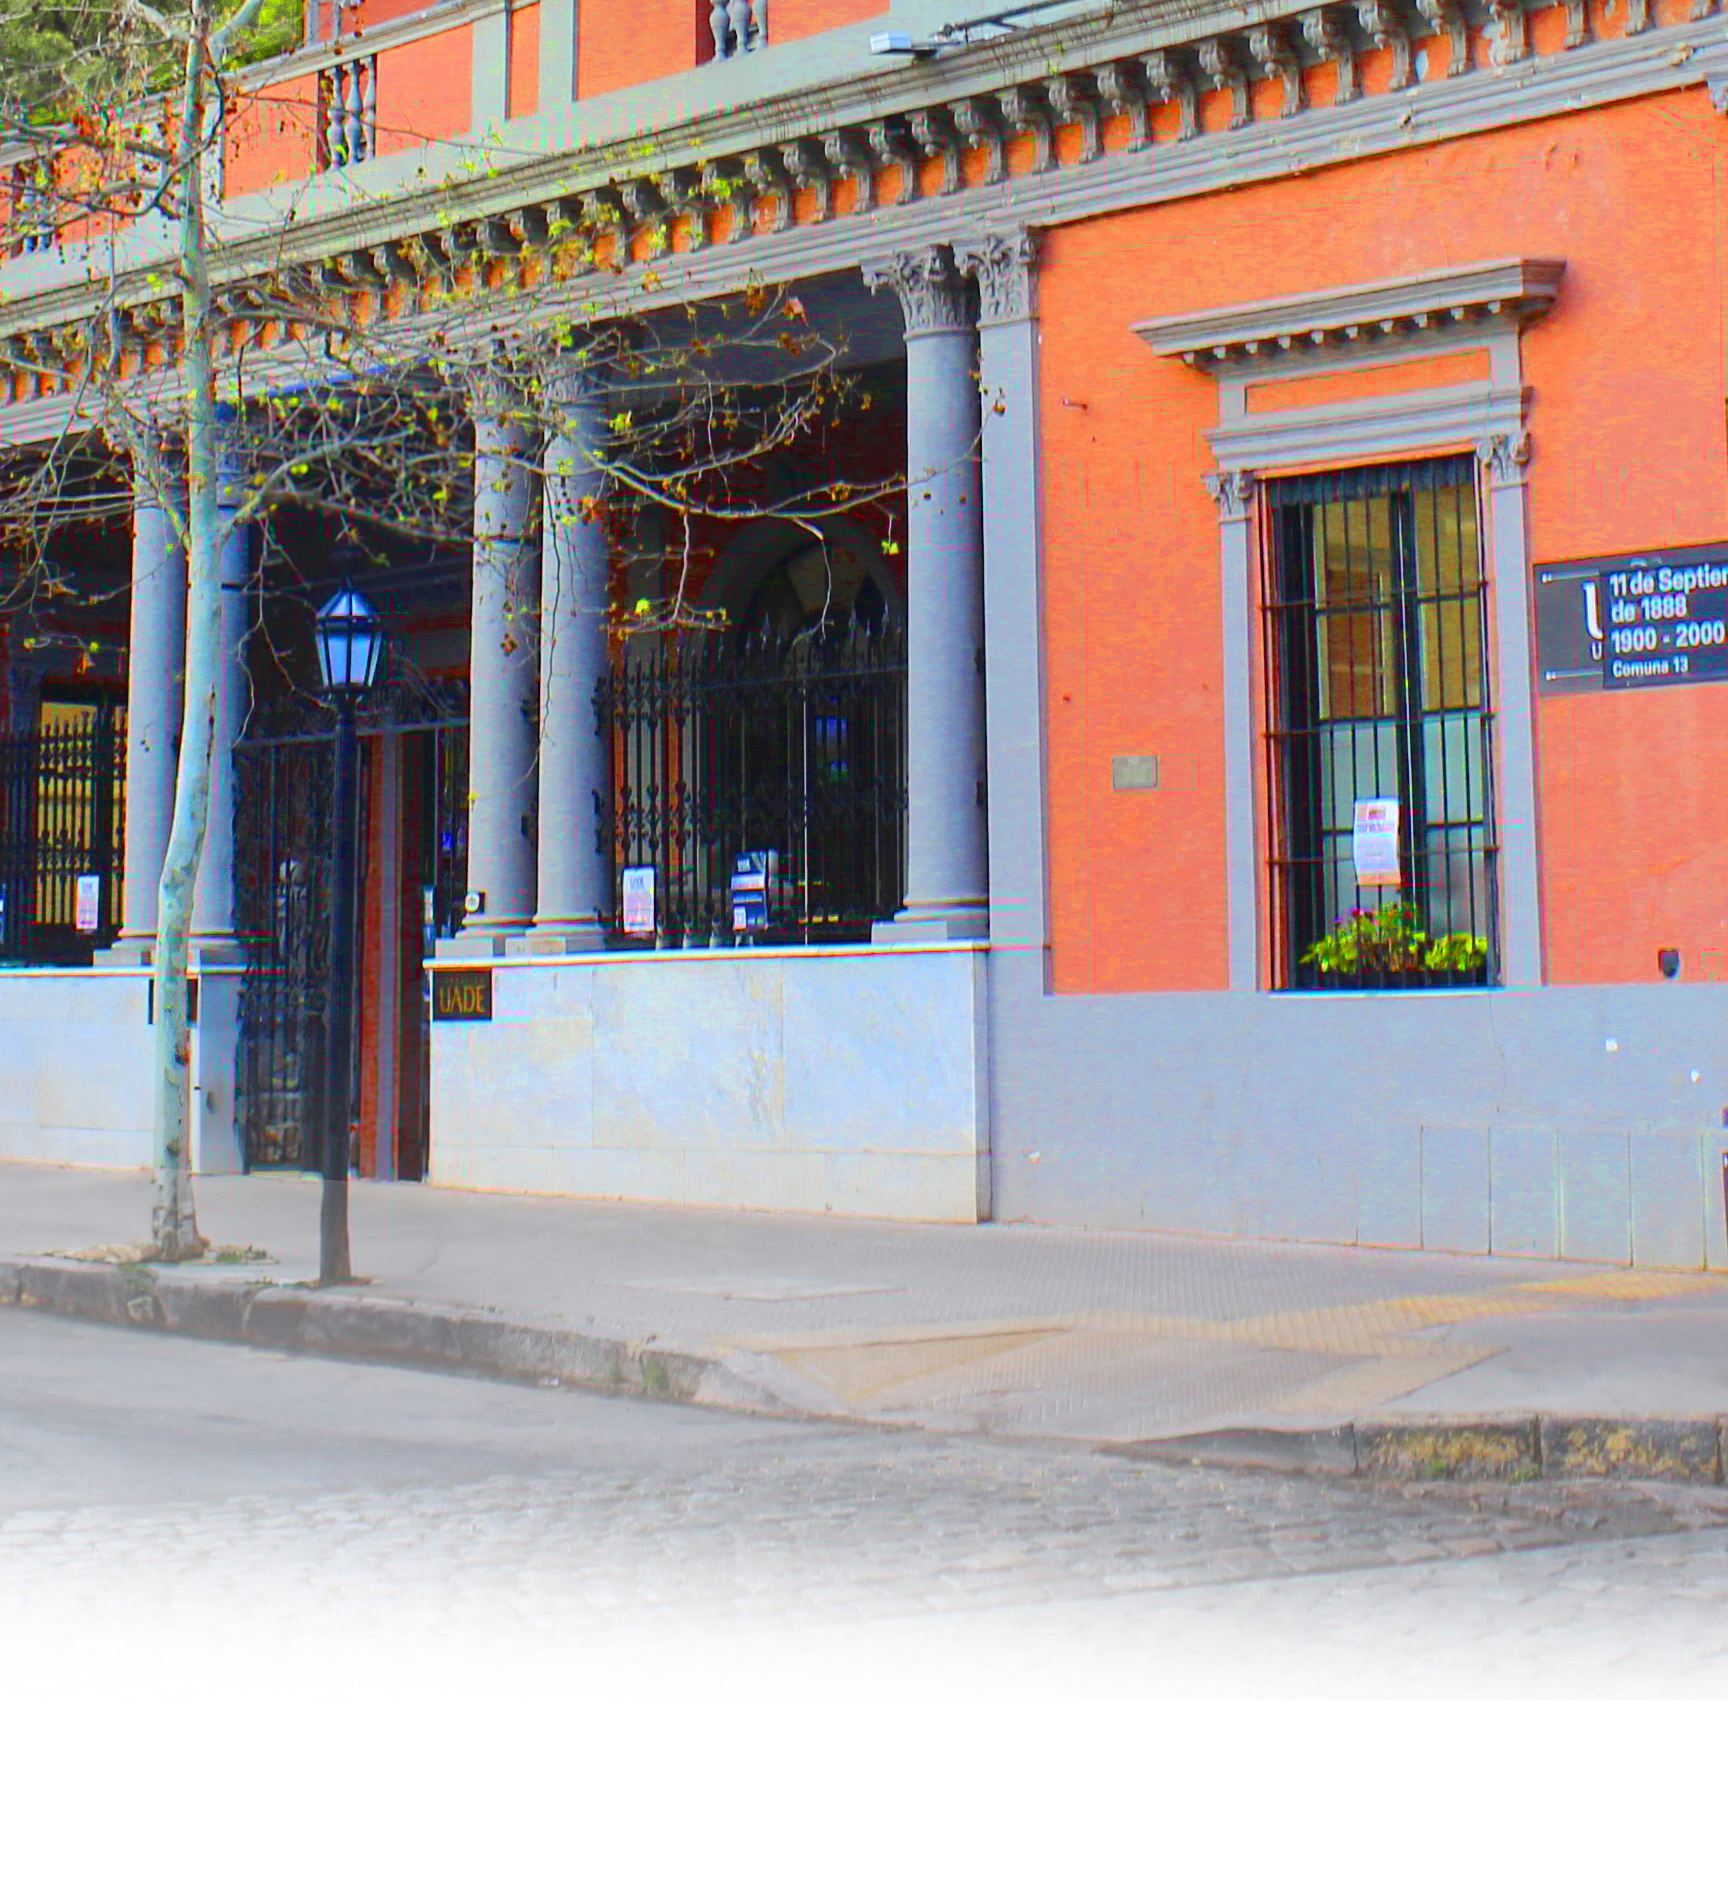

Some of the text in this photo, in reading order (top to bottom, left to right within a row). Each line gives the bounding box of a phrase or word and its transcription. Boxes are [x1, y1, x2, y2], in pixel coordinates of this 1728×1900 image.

[1610, 572, 1627, 597] 11
[1630, 569, 1655, 596] de
[1612, 598, 1636, 623] de
[1641, 593, 1688, 621] 1888
[1611, 626, 1658, 653] 1900
[1675, 619, 1726, 648] 2000
[1612, 654, 1689, 678] Comuna 13
[439, 986, 486, 1013] UADE
